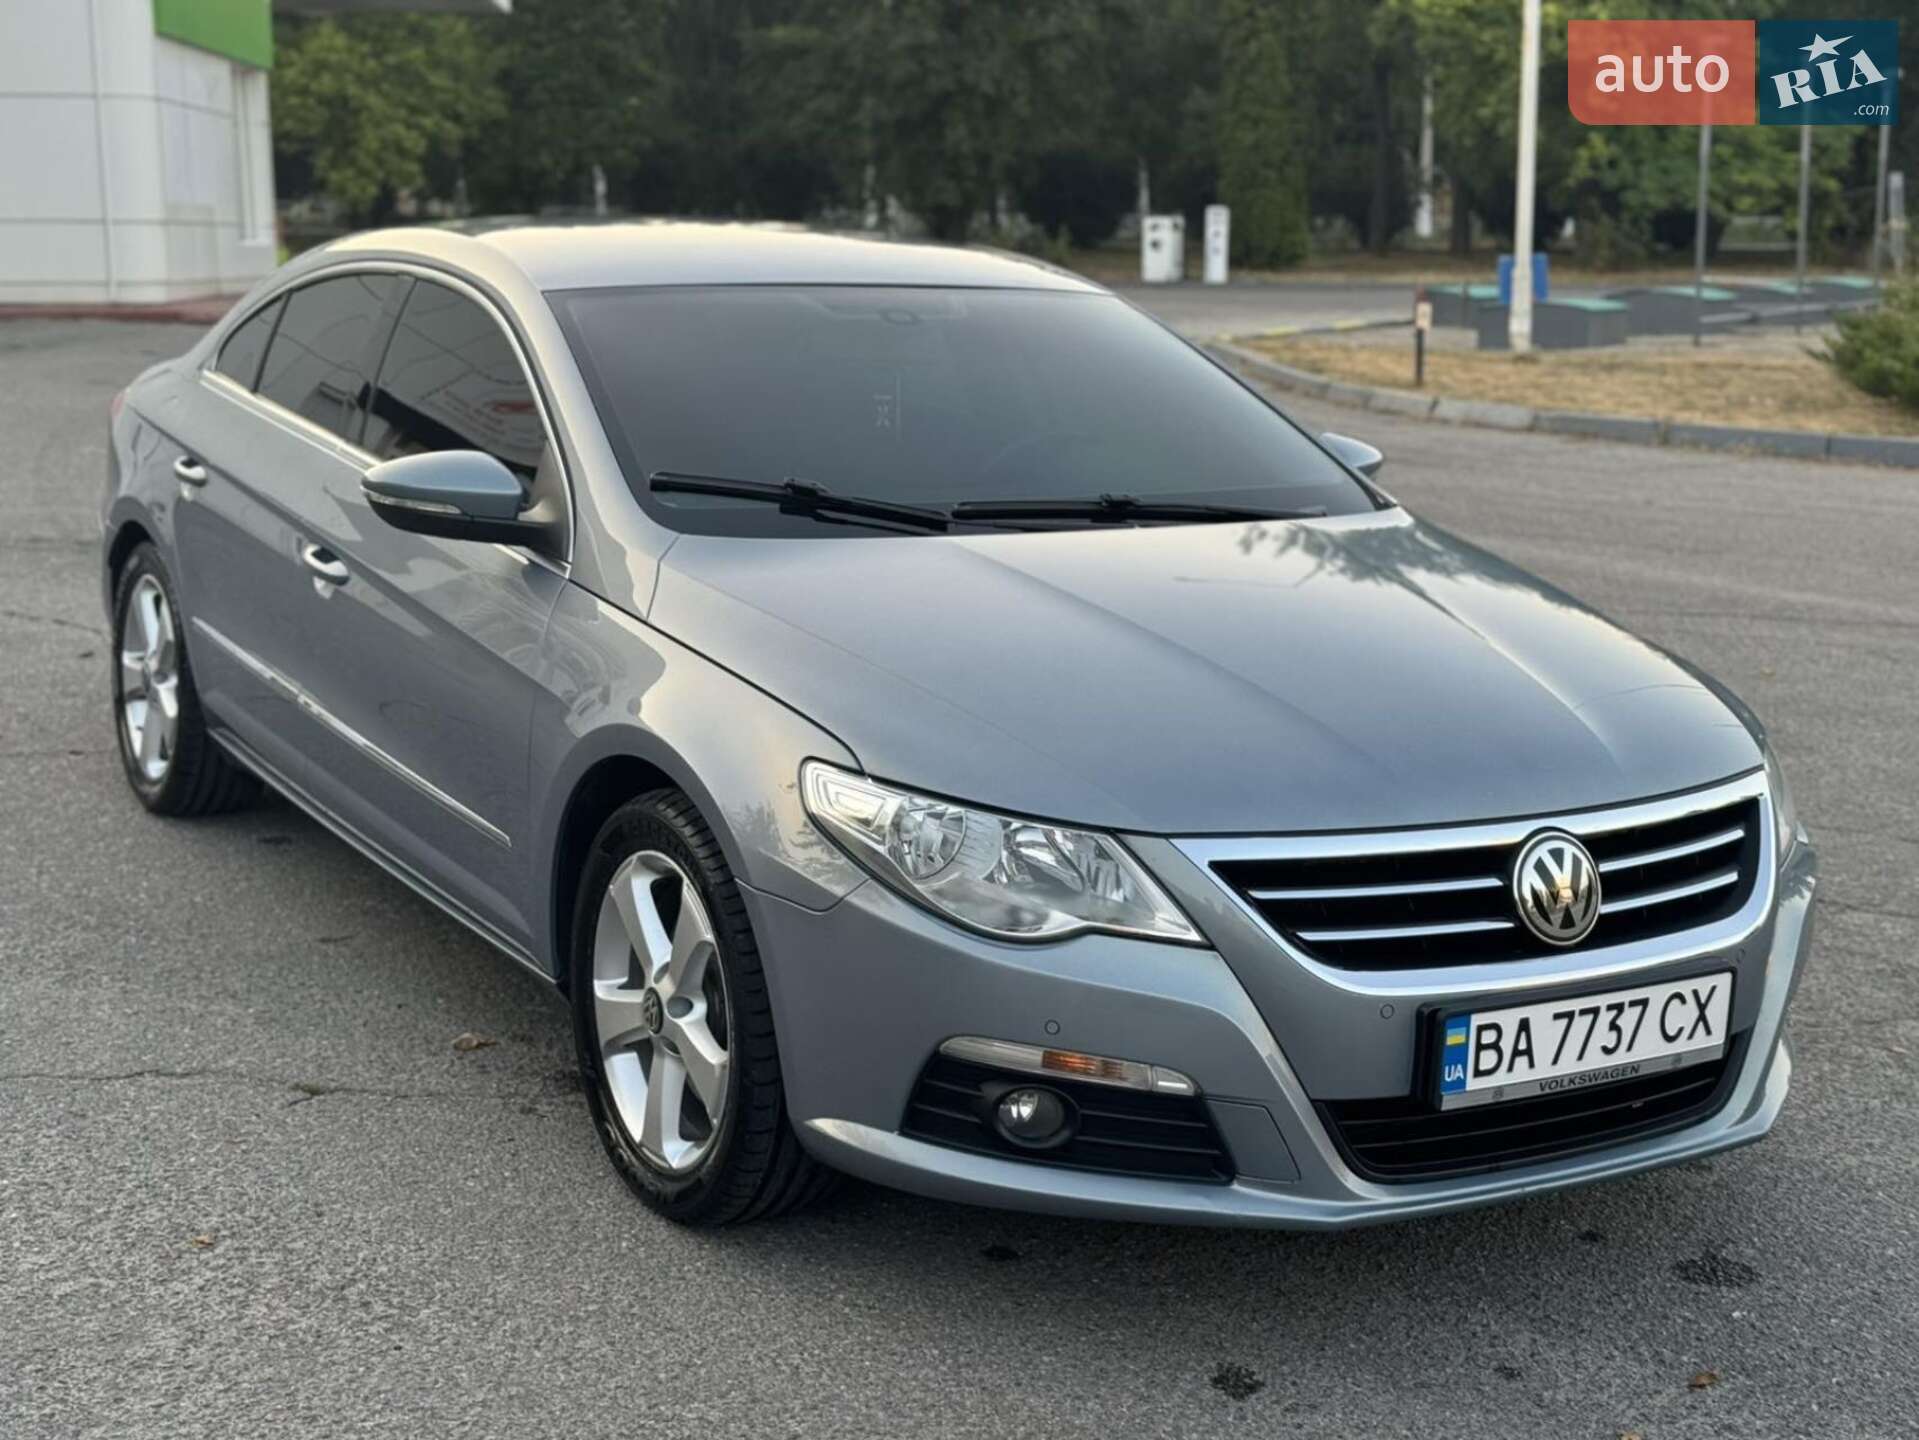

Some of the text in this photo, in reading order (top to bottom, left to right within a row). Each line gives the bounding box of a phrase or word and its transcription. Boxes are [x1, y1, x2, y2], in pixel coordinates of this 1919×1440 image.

[1518, 837, 1598, 940] VW
[1472, 984, 1718, 1079] BA 7737 CX
[1444, 1063, 1465, 1082] UA
[1539, 1063, 1640, 1092] VOLKSWAGEN
